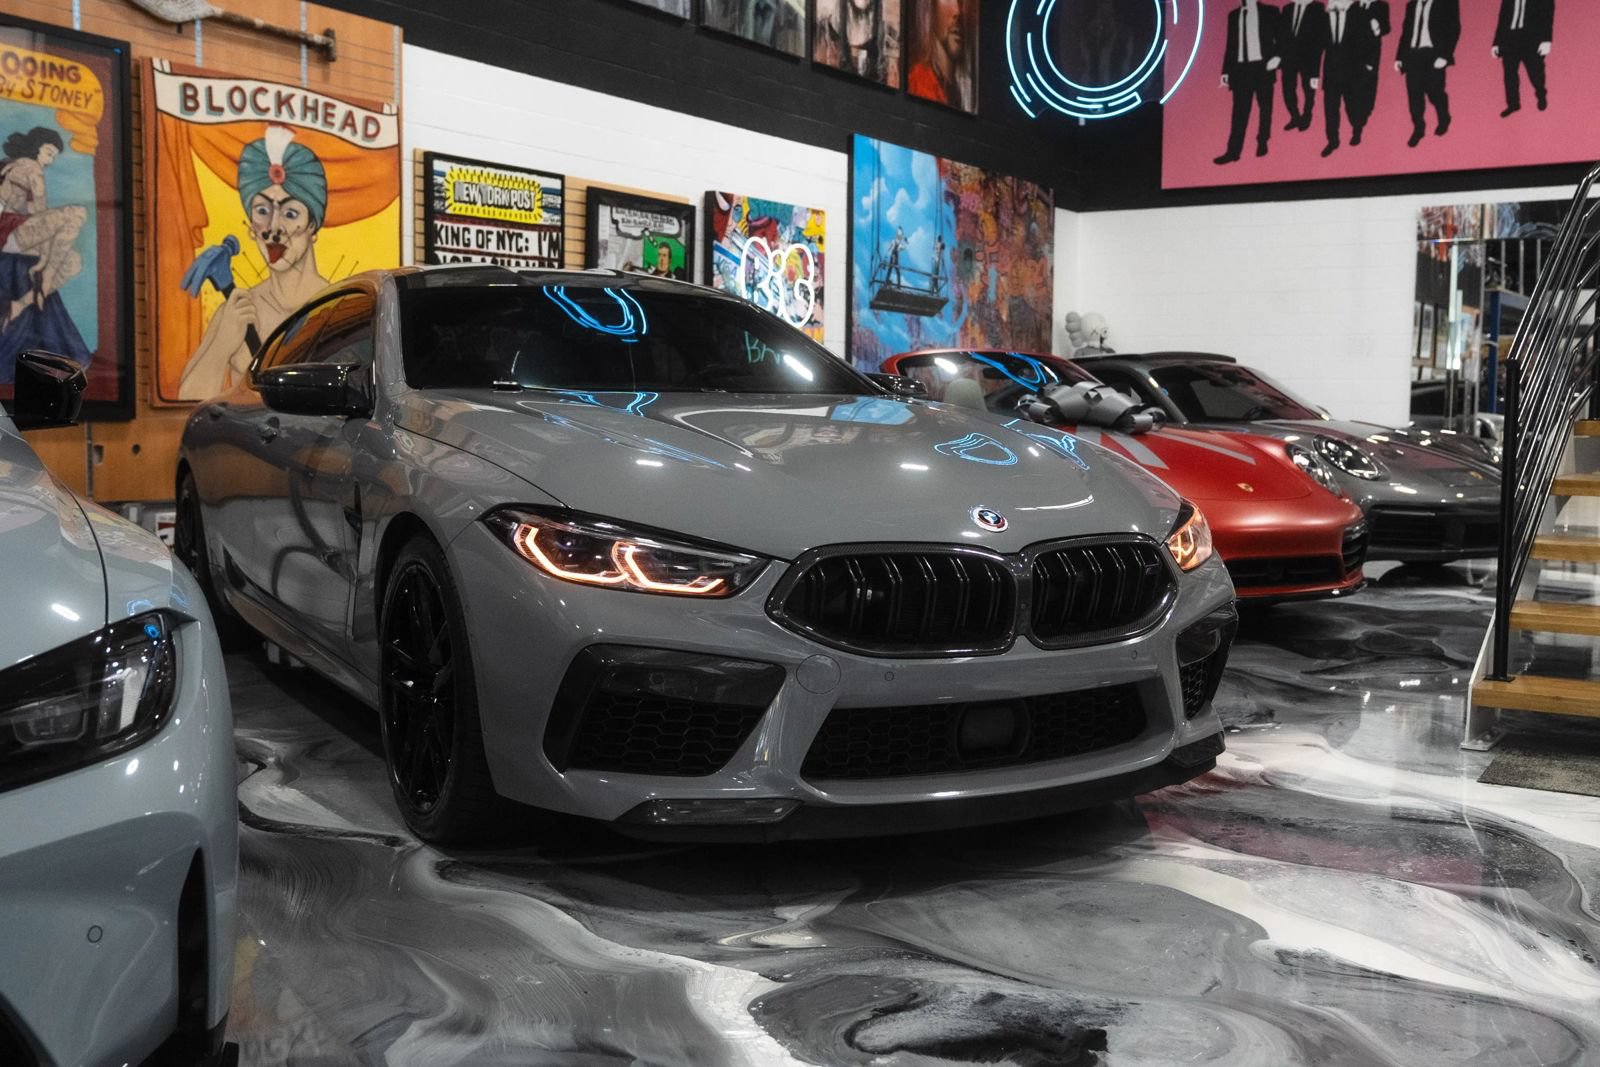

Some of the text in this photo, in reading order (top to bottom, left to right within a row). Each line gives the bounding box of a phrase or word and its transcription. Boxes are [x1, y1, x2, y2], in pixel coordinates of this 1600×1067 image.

[179, 82, 382, 141] BLOCKHEAD
[479, 184, 510, 208] YORK
[511, 190, 536, 210] POST
[434, 224, 561, 259] KING OF NYC: I'M
